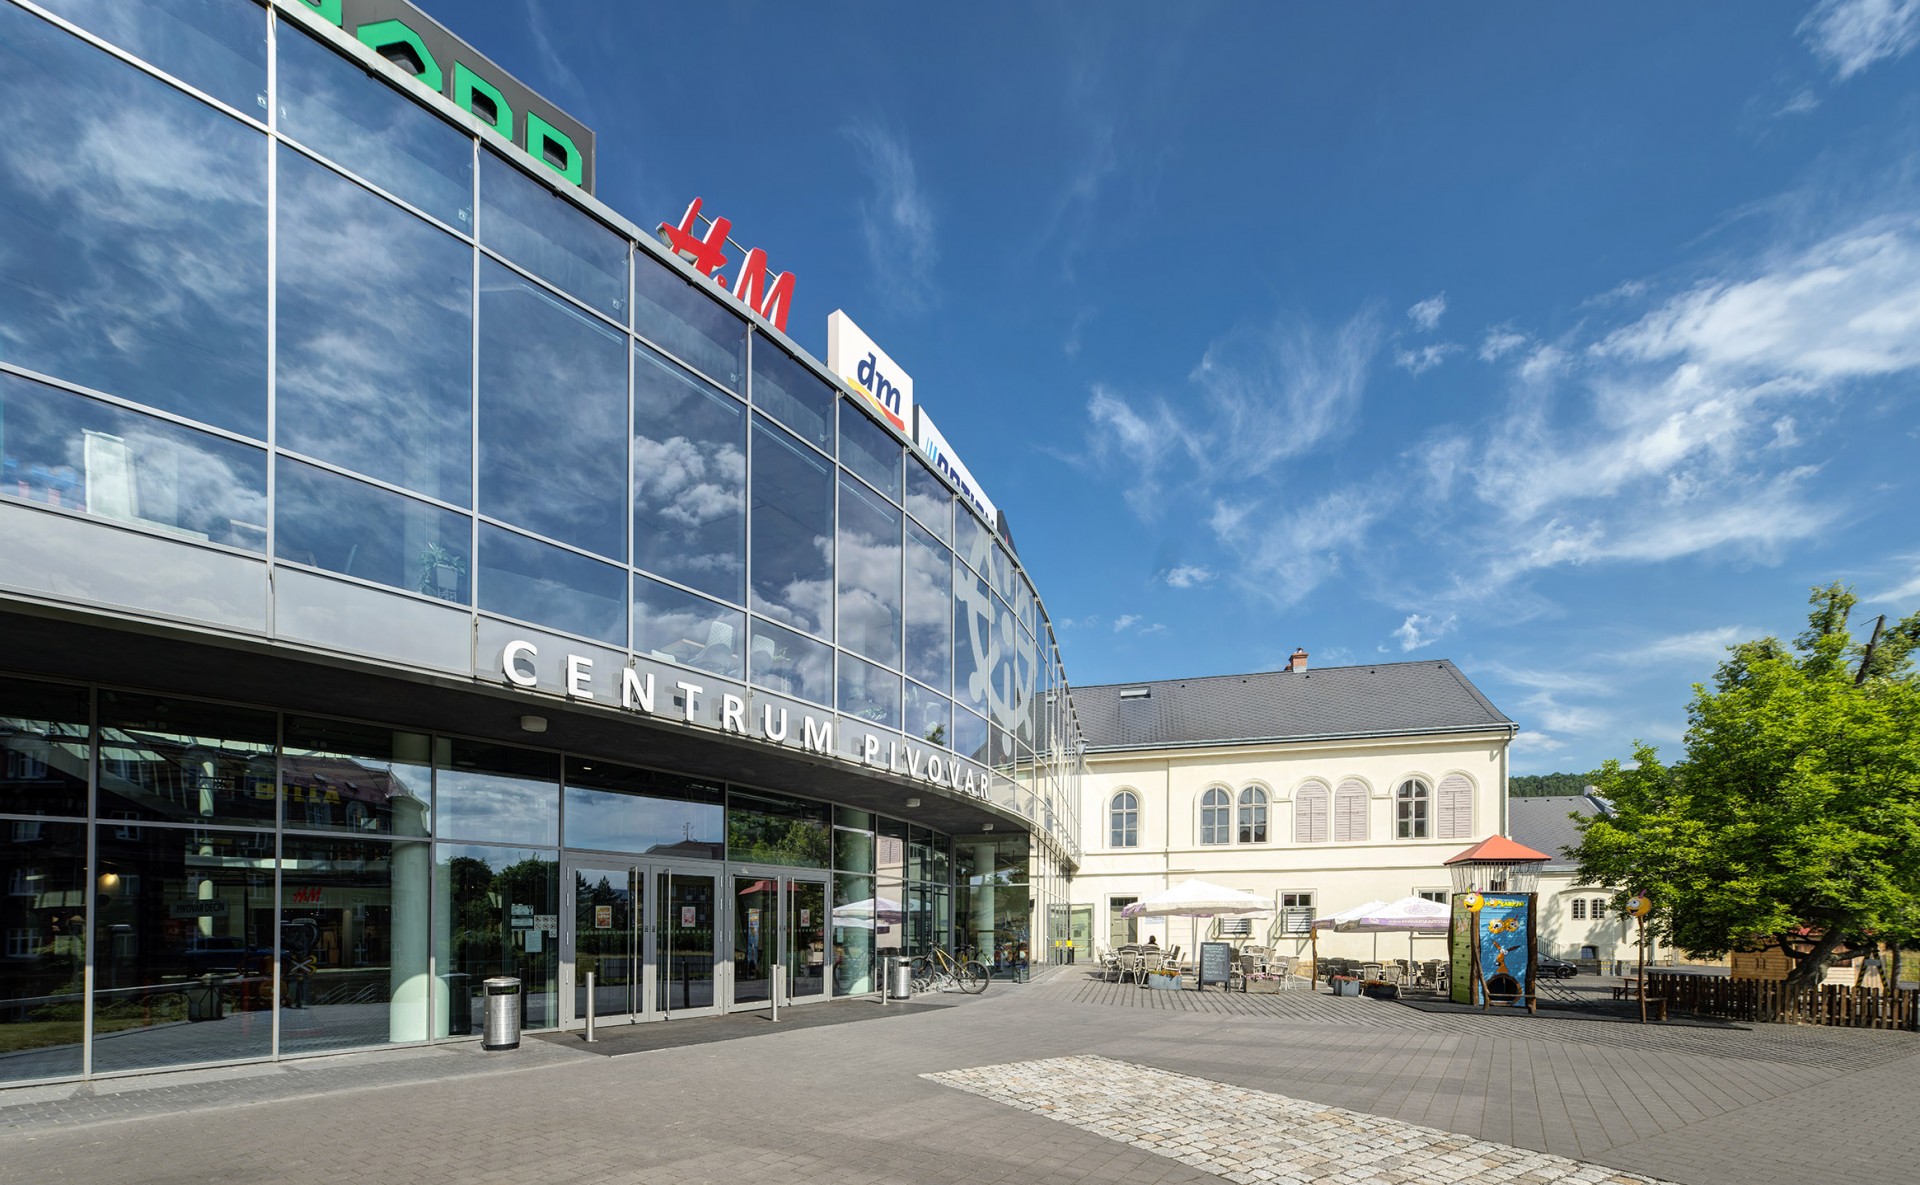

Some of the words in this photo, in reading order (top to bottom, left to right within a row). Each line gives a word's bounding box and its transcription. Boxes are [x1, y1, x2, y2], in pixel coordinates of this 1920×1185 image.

[857, 351, 901, 416] dm
[502, 639, 833, 755] CENTRUM
[864, 733, 990, 800] PIVOVAR
